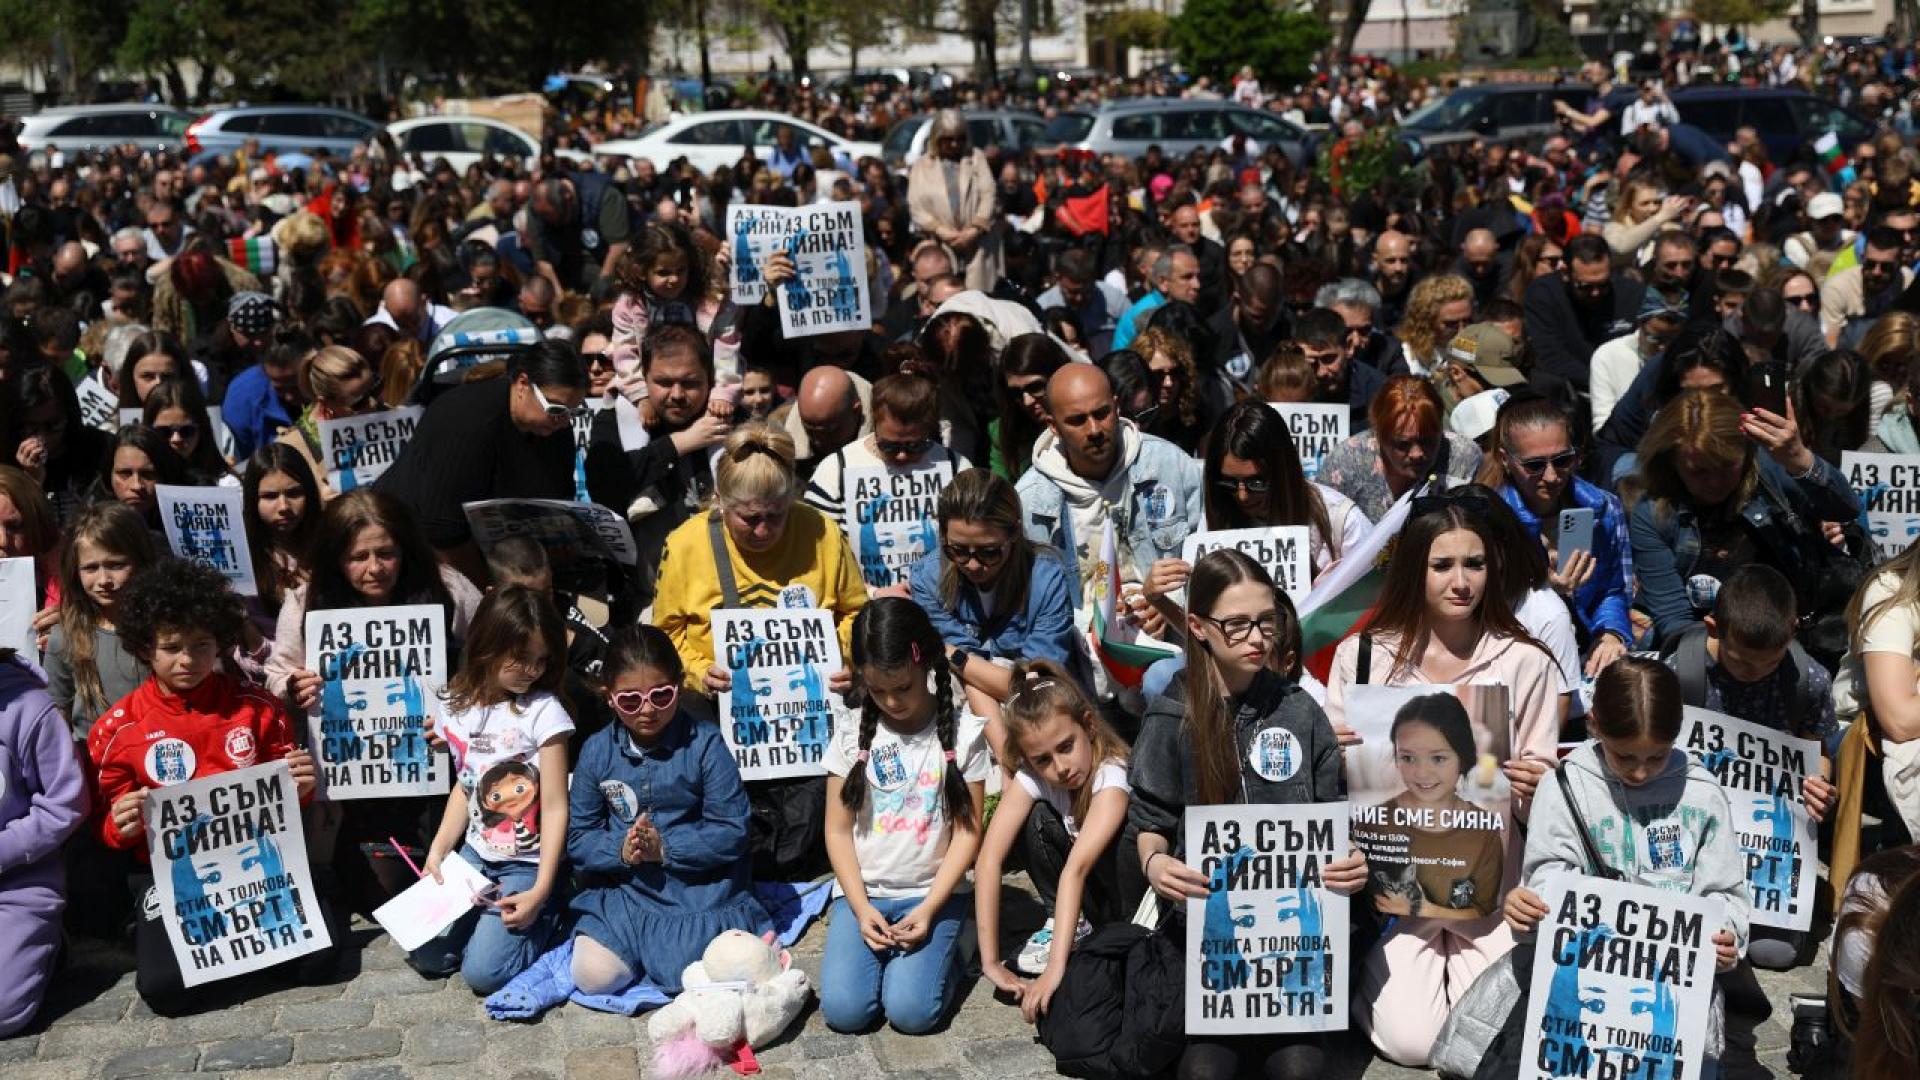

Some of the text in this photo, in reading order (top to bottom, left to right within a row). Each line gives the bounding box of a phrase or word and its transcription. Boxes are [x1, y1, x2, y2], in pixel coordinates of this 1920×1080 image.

[784, 211, 854, 234] АЗ СЪМ
[783, 231, 855, 254] СИЯНА!
[791, 312, 807, 327] НА
[332, 416, 416, 449] АЗ СЪМ
[1290, 412, 1339, 435] СЪМ
[334, 440, 397, 470] СИЯН
[855, 473, 942, 499] АЗ СЪМ
[1849, 463, 1879, 487] АЗ
[174, 502, 229, 517] АЗ СЪМ
[175, 515, 231, 531] СИЯНА!
[319, 617, 432, 651] АЗ СЪМ
[725, 617, 826, 643] АЗ СЪМ
[319, 648, 432, 682] СИЯНА!
[726, 640, 828, 671] СИЯНА!
[731, 699, 832, 718] СТИГА ТОЛКОВА
[321, 715, 427, 734] СТИГА ТОЛКОВ
[732, 717, 819, 746] СМЪРТ
[321, 733, 418, 764] СМЪРТ
[735, 749, 761, 769] НА
[1687, 720, 1805, 775] АЗ СЪМ
[325, 765, 352, 787] НА
[160, 774, 284, 829] АЗ СЪМ
[162, 803, 287, 861] СИЯНА!
[1353, 806, 1505, 831] НИЕ СМЕ СИЯНА
[1201, 818, 1335, 854] АЗ СЪМ
[175, 892, 225, 917] СТИГА
[228, 872, 296, 899] ТОЛКОВА
[180, 895, 284, 946] СМЪРТ
[1556, 890, 1704, 949] АЗ СЪМ
[1201, 935, 1331, 955] СТИГА ТОЛКОВА
[1552, 926, 1698, 988] СИЯНА!
[191, 948, 224, 970] НА
[1201, 956, 1314, 990] СМЪРТ
[1202, 994, 1234, 1019] НА
[1541, 1014, 1683, 1057] СТИГА ТОЛКОВА
